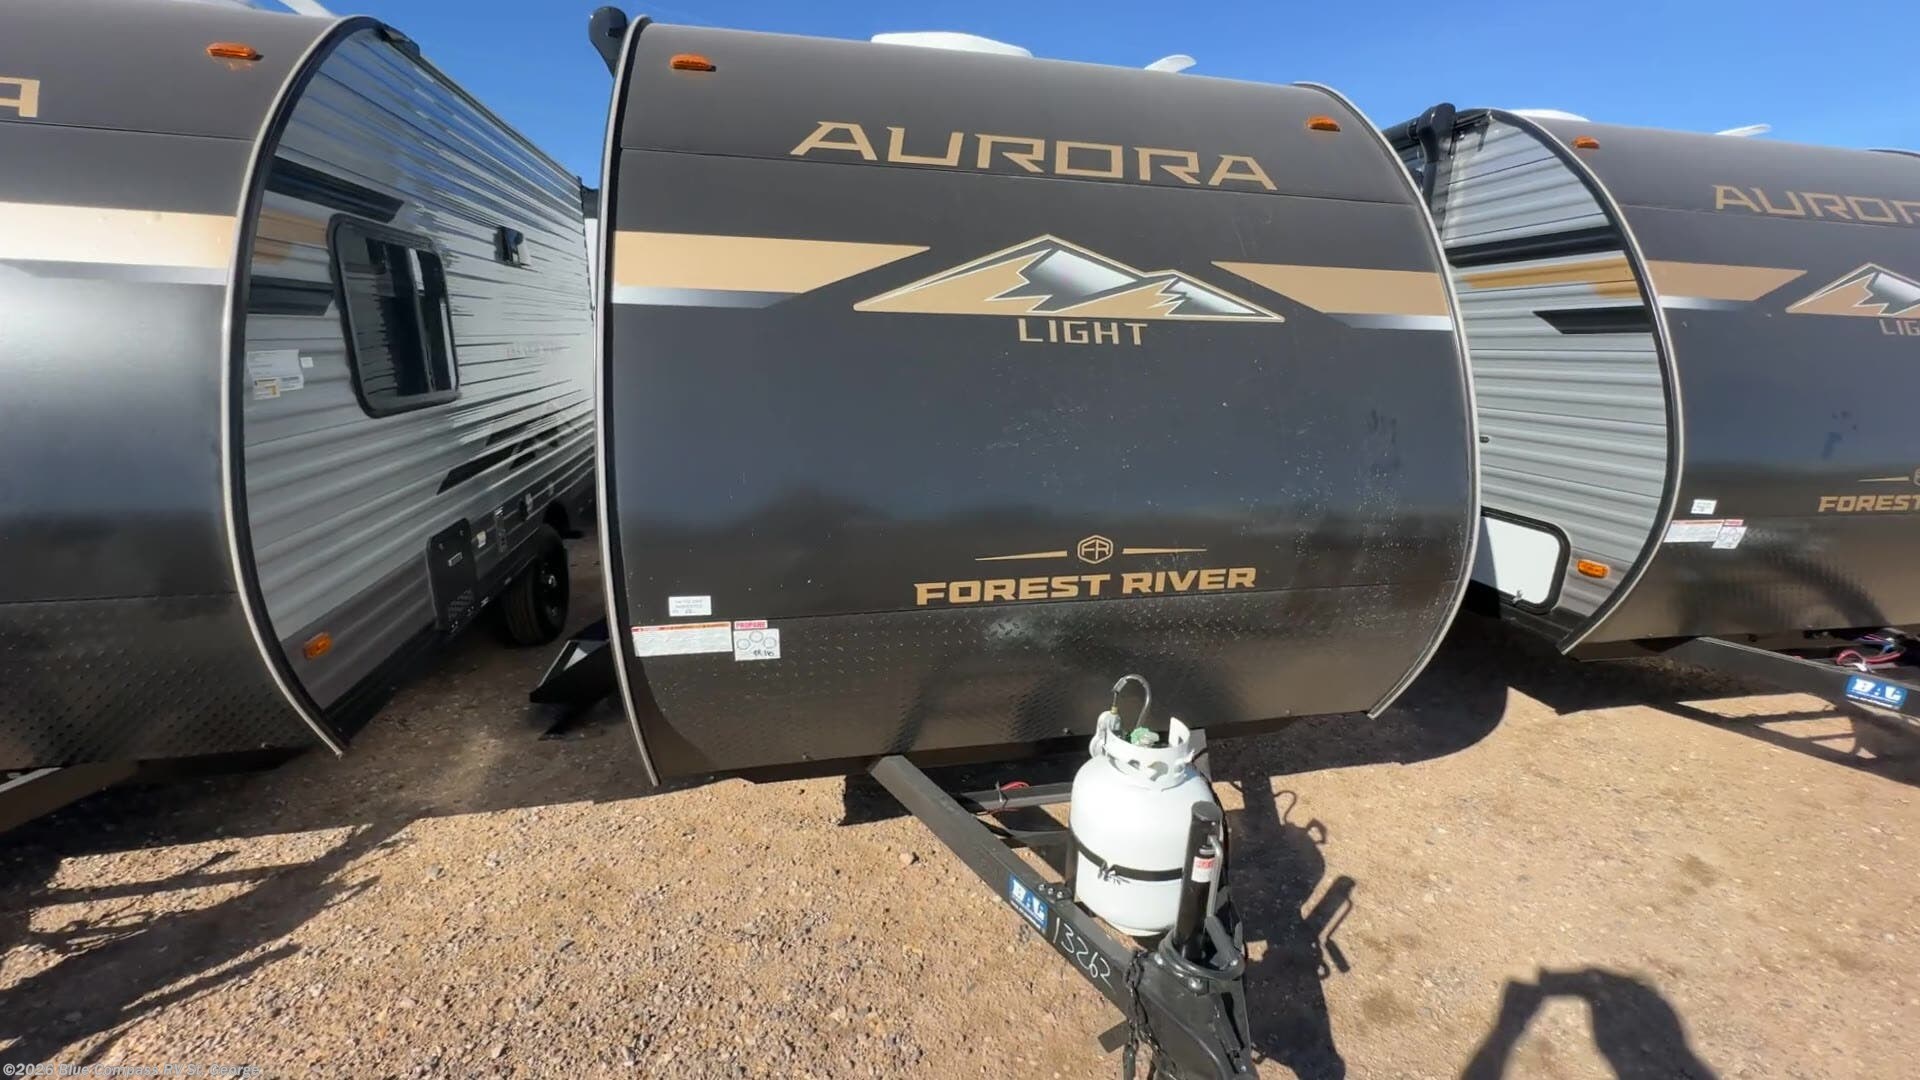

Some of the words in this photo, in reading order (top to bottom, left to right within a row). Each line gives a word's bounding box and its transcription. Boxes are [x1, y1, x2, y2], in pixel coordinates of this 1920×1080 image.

[790, 121, 1278, 190] AURORA
[1017, 318, 1148, 345] LIGHT
[914, 574, 1111, 605] FOREST
[1121, 567, 1257, 594] RIVER
[1052, 917, 1116, 992] 13262
